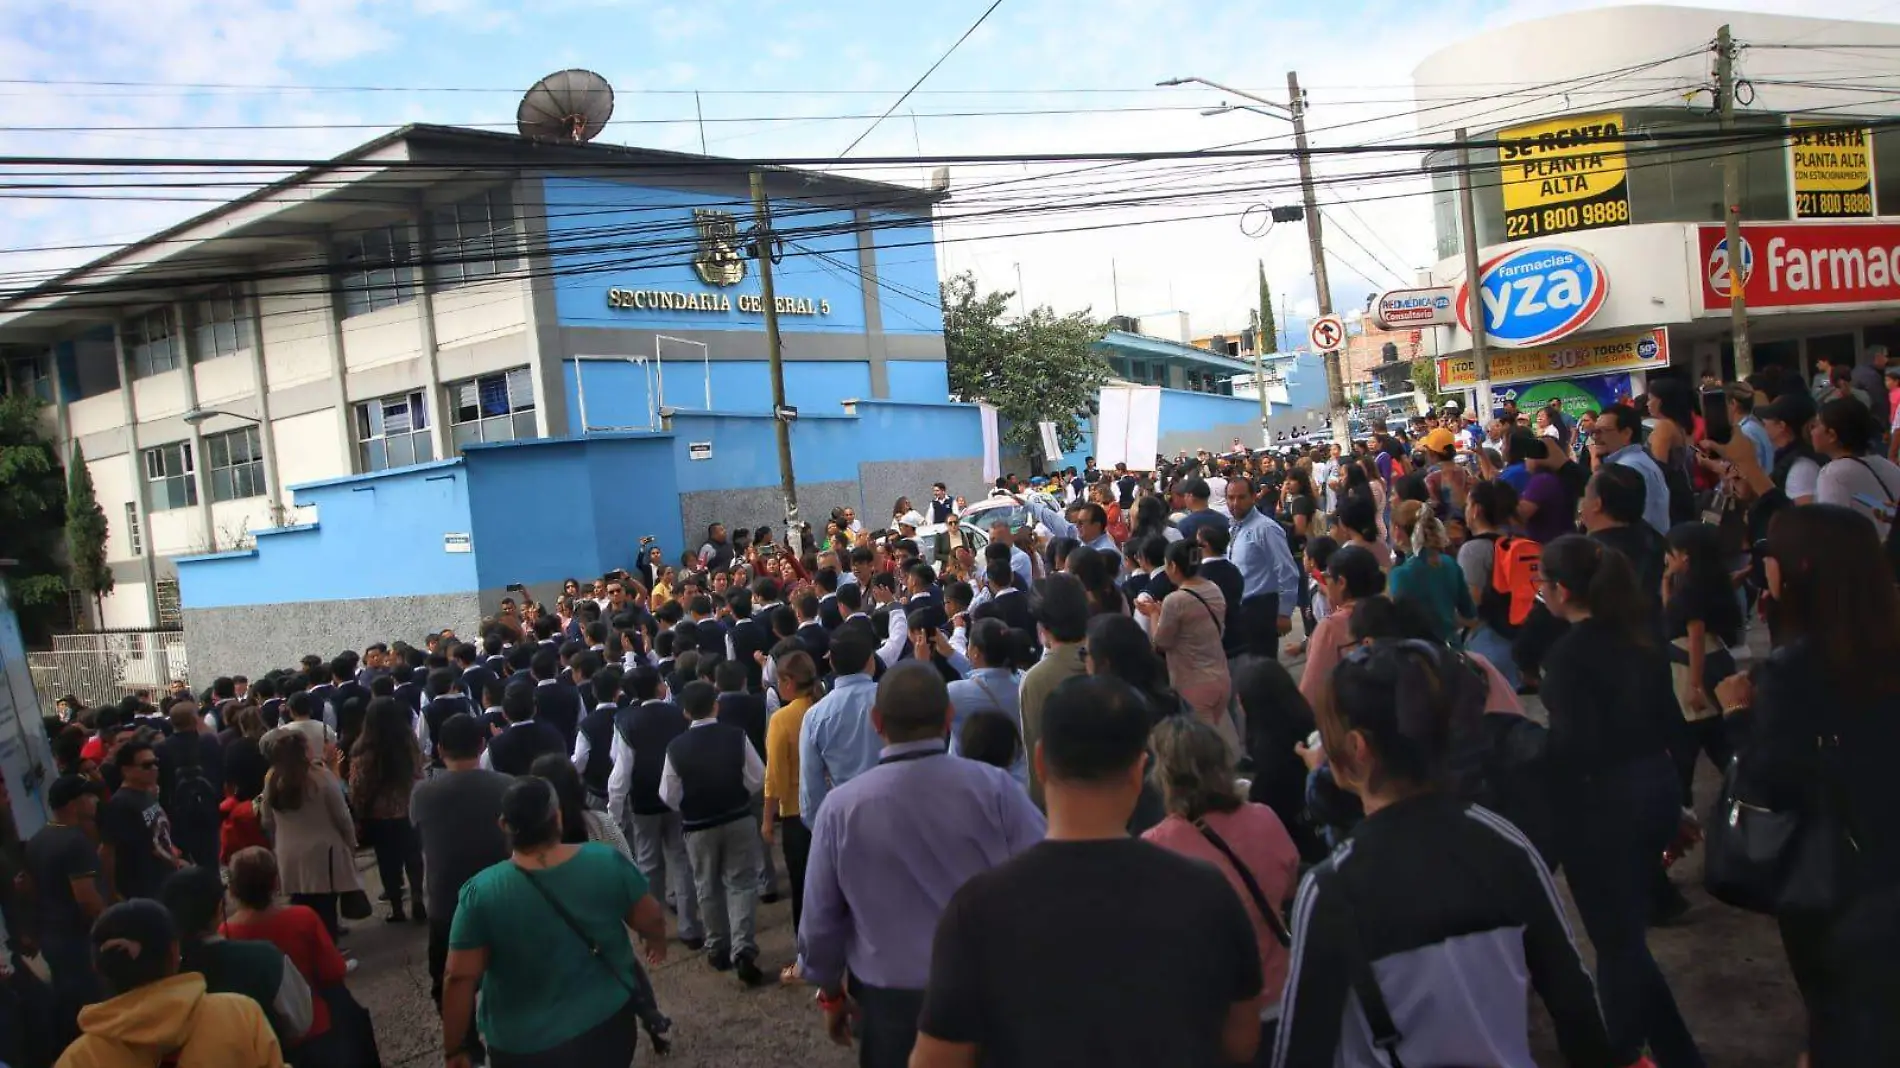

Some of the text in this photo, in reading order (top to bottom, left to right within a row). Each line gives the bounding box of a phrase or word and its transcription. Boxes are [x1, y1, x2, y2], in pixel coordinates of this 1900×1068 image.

[1523, 155, 1603, 179] PLANTA
[1795, 152, 1866, 168] PLANTA ALTA
[1540, 175, 1588, 197] ALTA
[1797, 193, 1871, 213] 221 800 9888
[1506, 200, 1628, 237] 221 800 9888
[609, 288, 831, 315] SECUNDARIA GEERAL 5
[1481, 269, 1583, 330] yza
[1386, 309, 1433, 321] Consultorio
